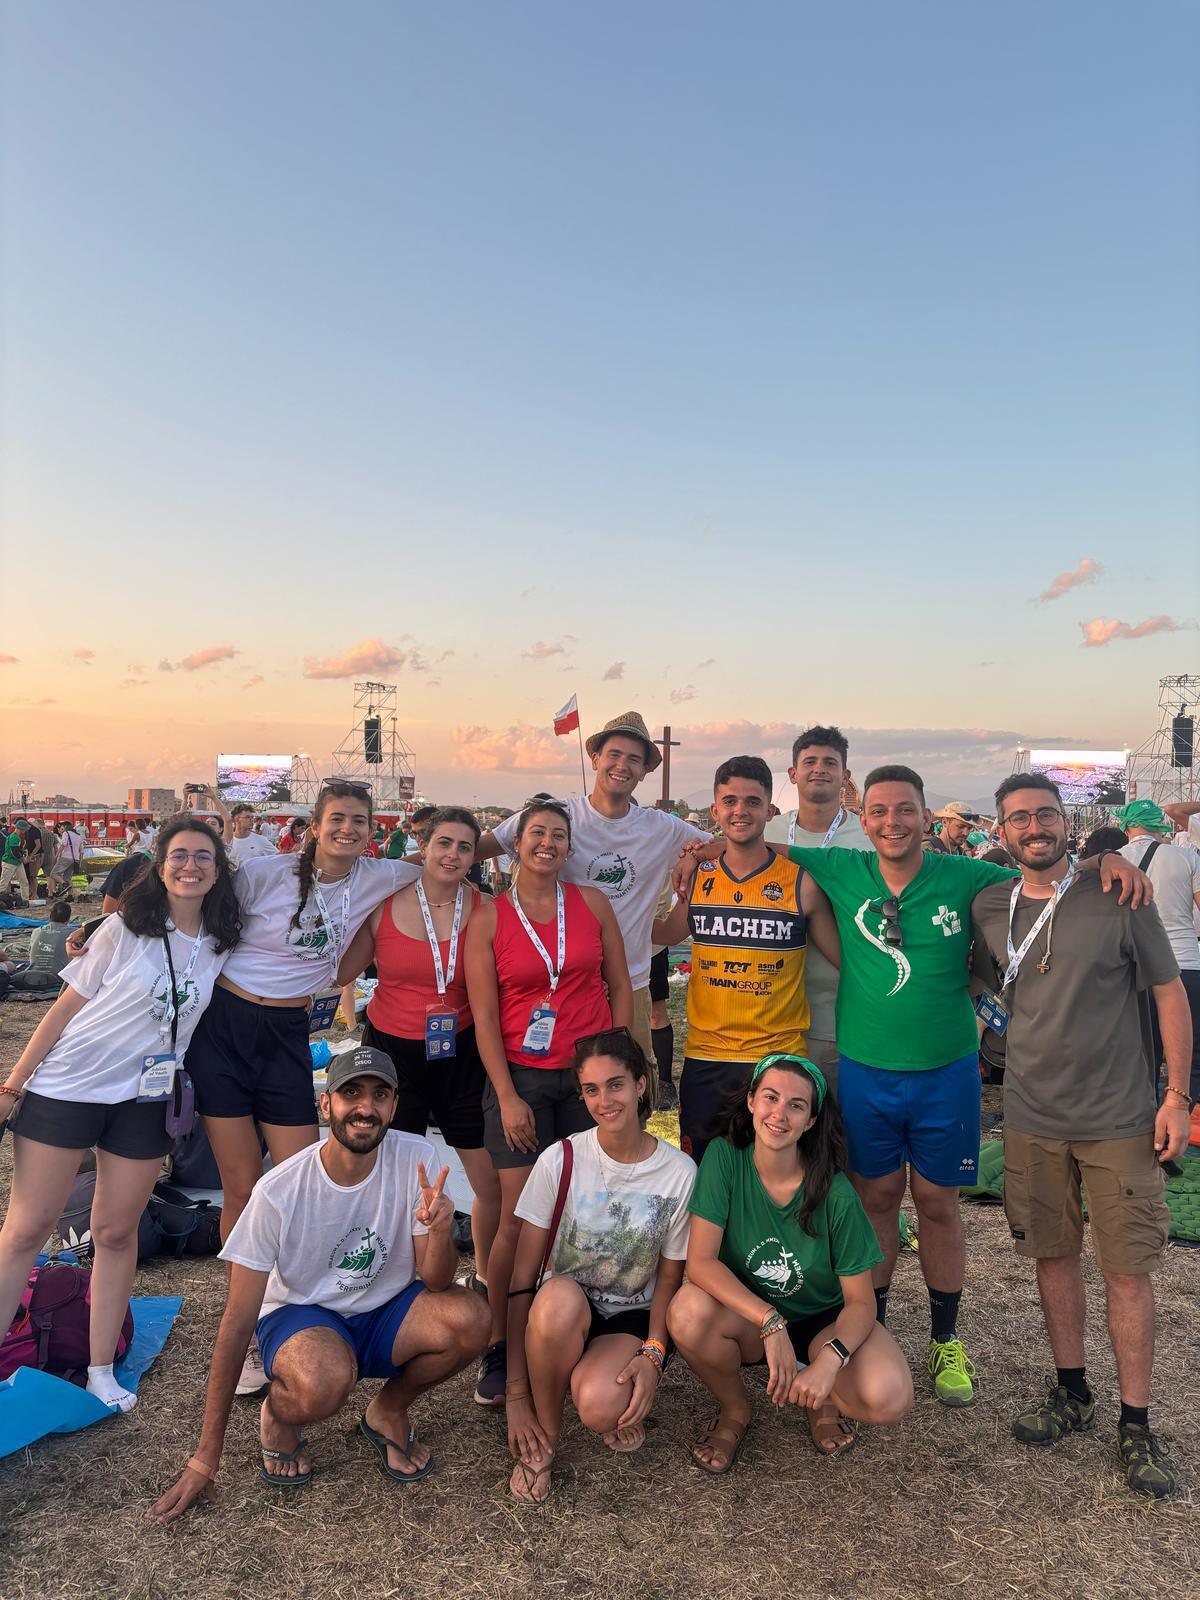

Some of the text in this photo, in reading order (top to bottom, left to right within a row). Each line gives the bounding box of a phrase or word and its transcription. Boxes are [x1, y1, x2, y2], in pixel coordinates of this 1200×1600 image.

[702, 877, 716, 897] 4
[692, 914, 794, 941] ELACHEM
[723, 960, 752, 974] TCT
[757, 962, 776, 970] asm
[709, 976, 773, 991] MAINGROUP
[791, 1258, 804, 1279] SPEM
